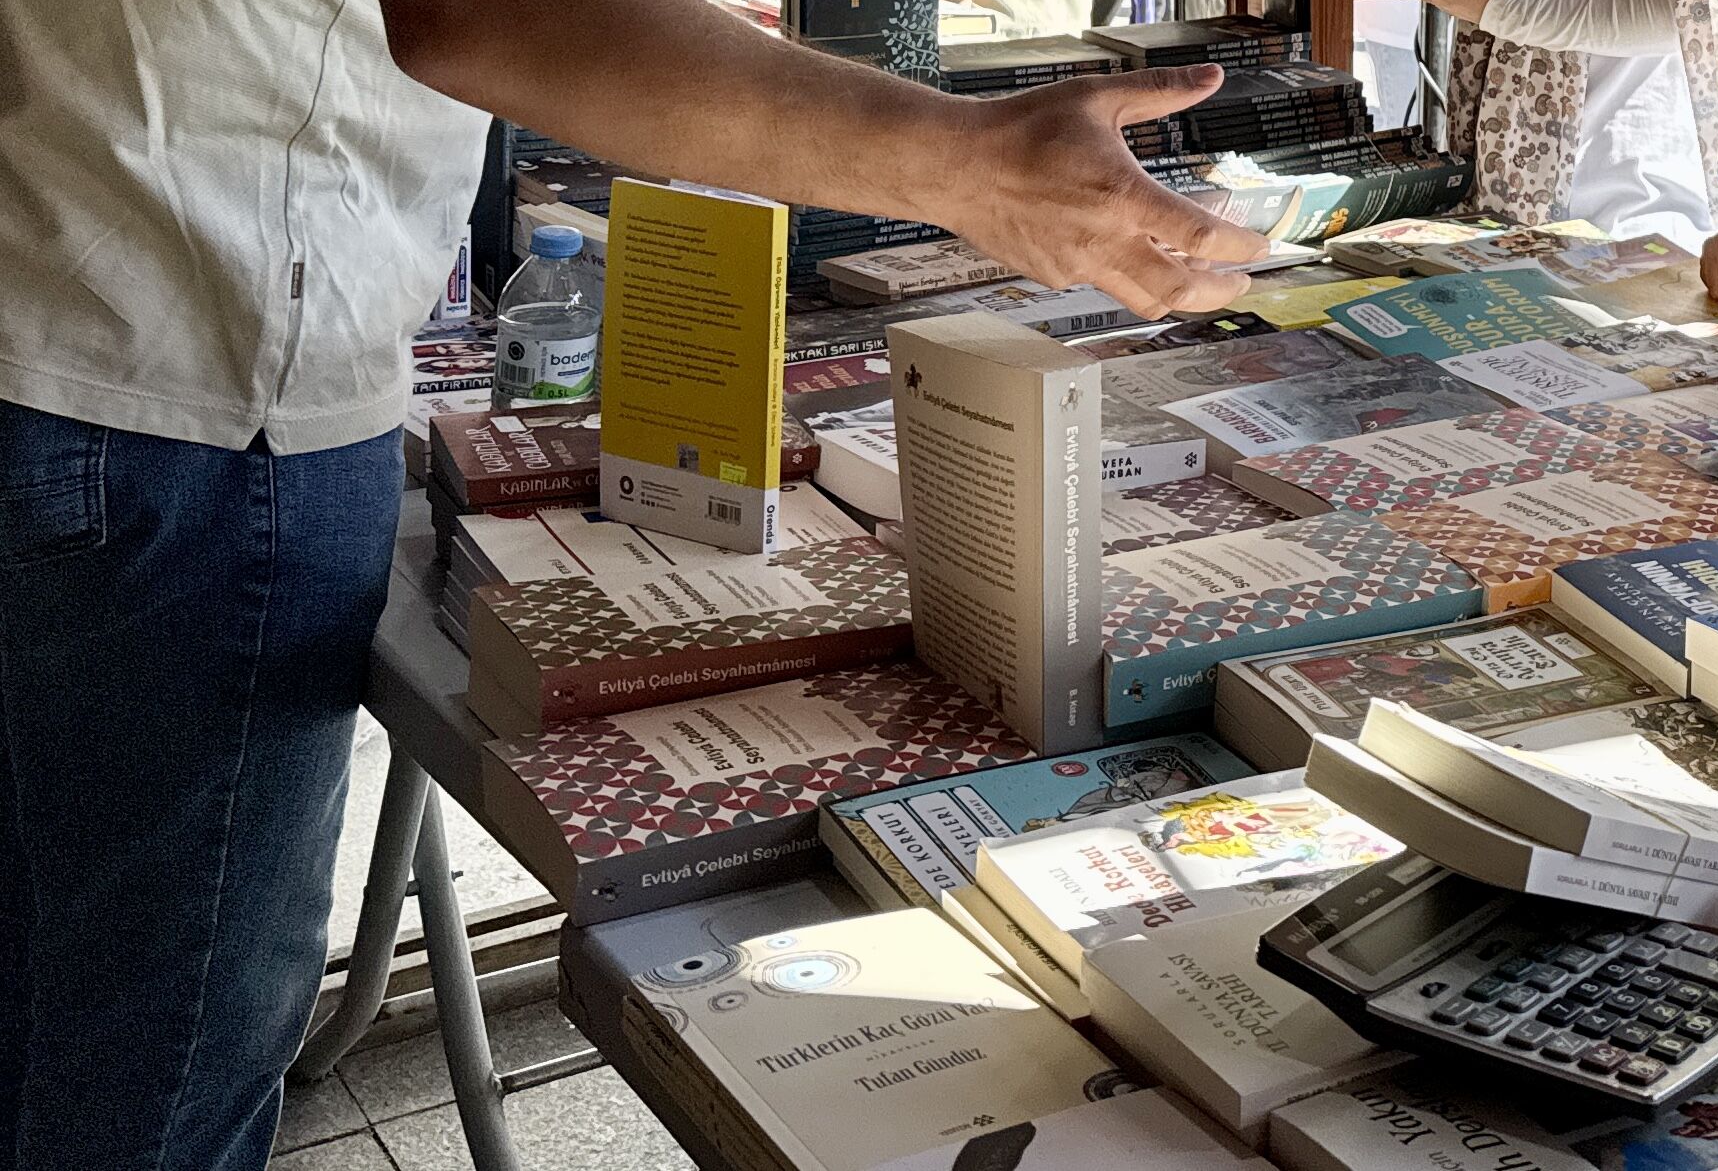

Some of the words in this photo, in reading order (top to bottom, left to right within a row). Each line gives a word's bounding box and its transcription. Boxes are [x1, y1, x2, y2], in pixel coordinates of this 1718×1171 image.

[830, 341, 860, 357] SARI
[441, 377, 492, 391] FIRTINA
[1066, 425, 1079, 474] Evliyâ
[1102, 457, 1132, 468] VEFA
[1066, 476, 1079, 523] Çelebi
[766, 504, 776, 545] Orenda
[1066, 525, 1079, 647] Seyahatnâmesi
[599, 678, 646, 695] Evliyâ
[648, 671, 699, 690] Çelebi
[701, 654, 817, 682] Seyahatnâmesi
[877, 813, 932, 861] KORKUT
[1651, 848, 1678, 864] DÜNYA
[641, 866, 692, 888] Evliyâ
[695, 854, 749, 875] Çelebi
[752, 836, 823, 862] Seyahat
[925, 866, 956, 891] EDE
[1598, 881, 1626, 897] DÜNYA
[756, 1034, 863, 1074] Türklerin
[857, 1023, 905, 1048] Kaç
[900, 1008, 956, 1031] Gözü
[853, 1066, 915, 1093] Tufan
[912, 1046, 988, 1076] Gündüz
